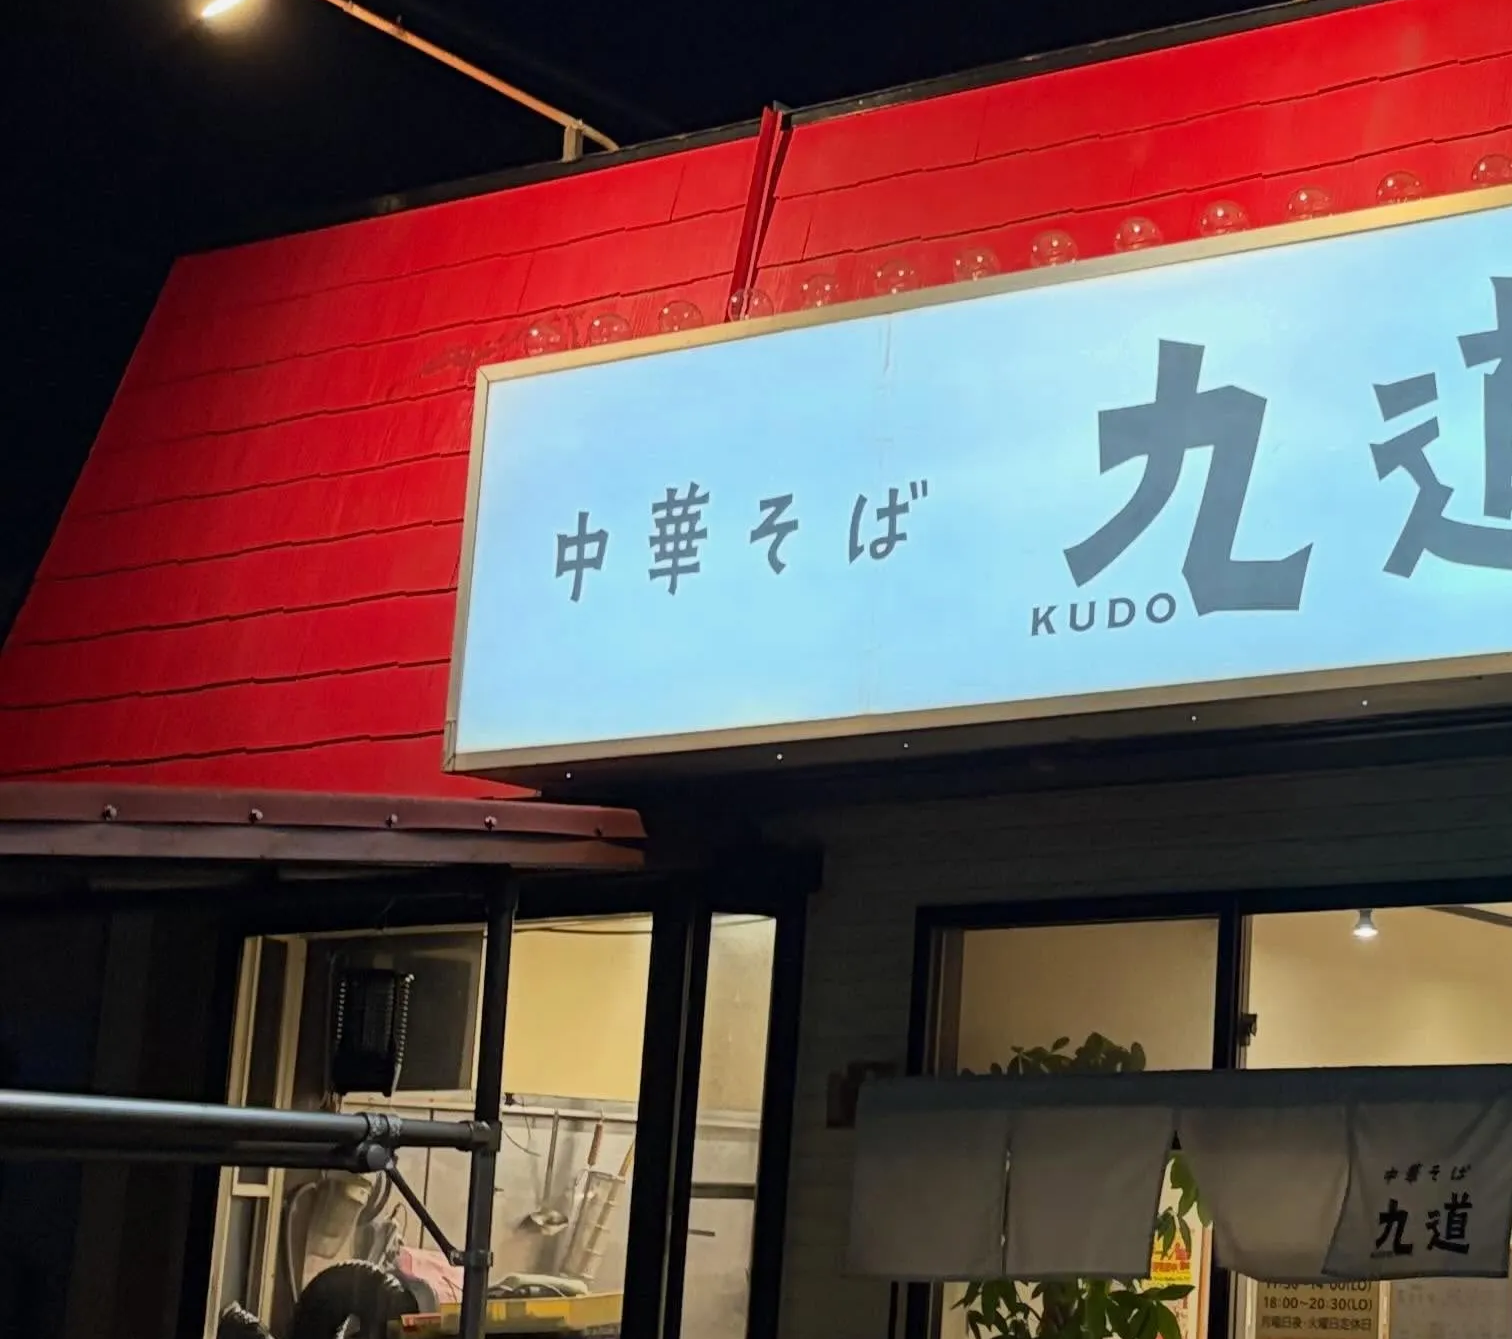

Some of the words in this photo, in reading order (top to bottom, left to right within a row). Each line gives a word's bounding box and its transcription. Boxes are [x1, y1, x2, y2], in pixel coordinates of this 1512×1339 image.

[555, 479, 929, 603] 中華そば
[1031, 592, 1178, 637] KUDO
[1375, 1191, 1473, 1254] 九道
